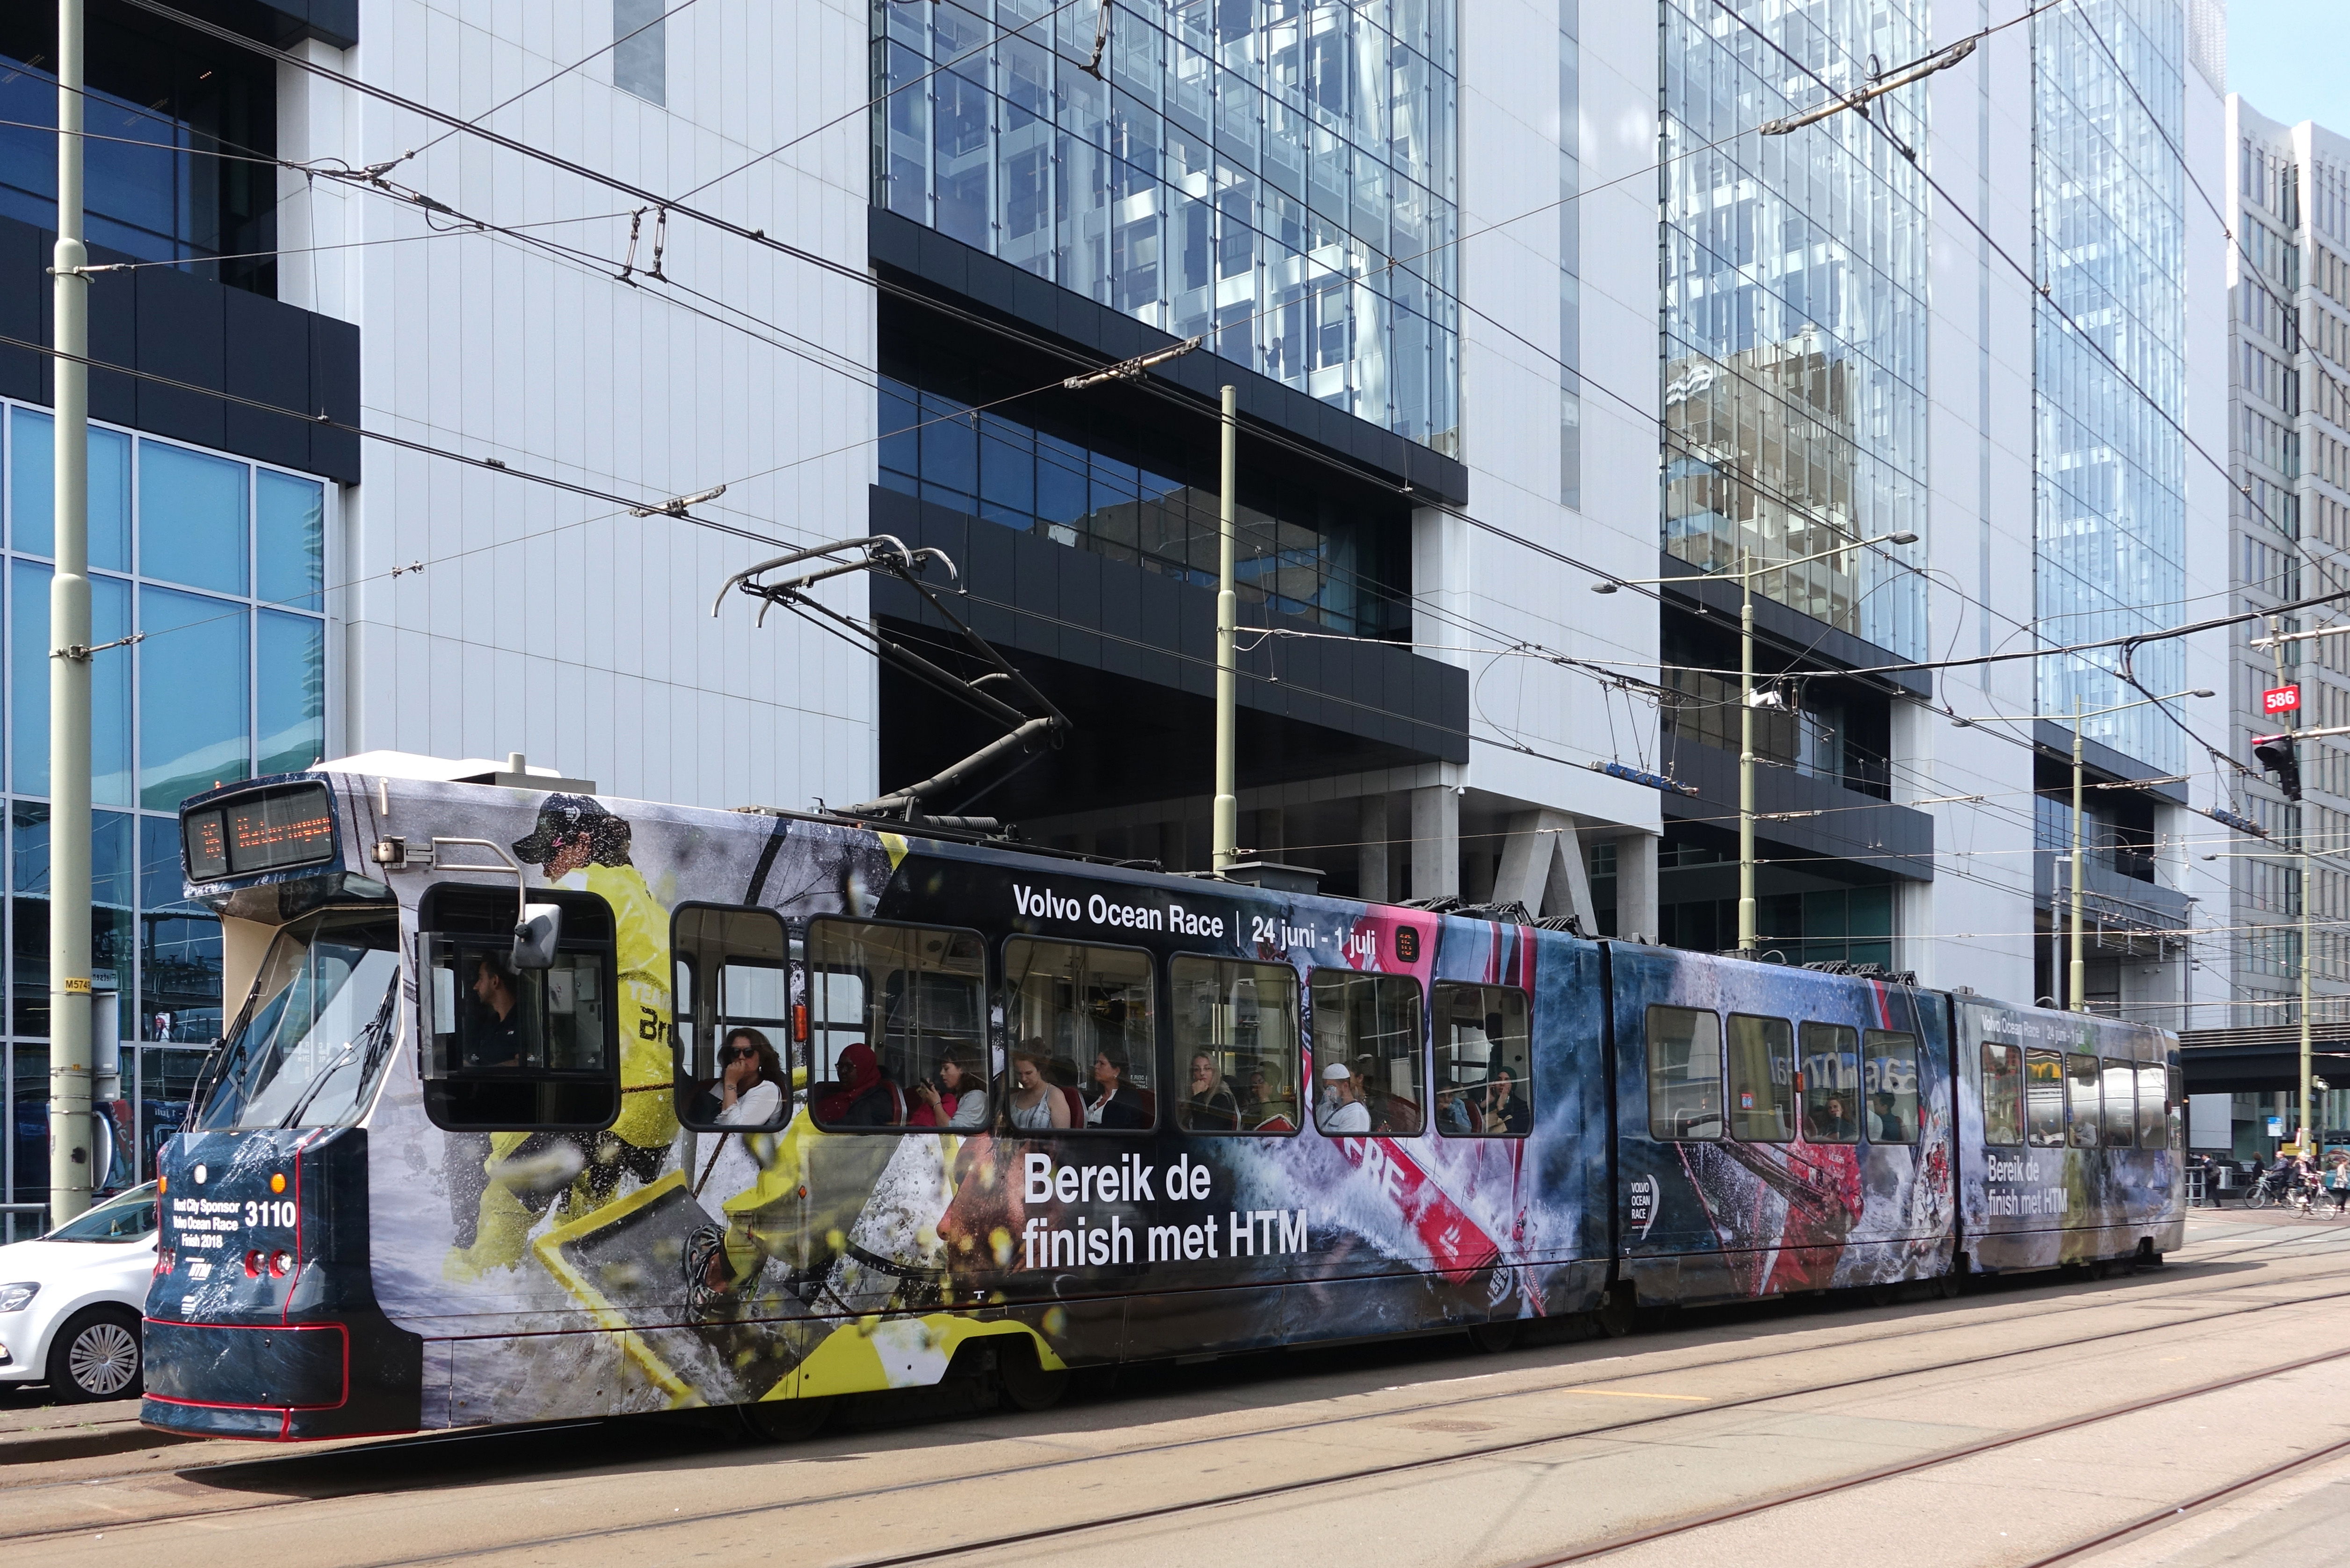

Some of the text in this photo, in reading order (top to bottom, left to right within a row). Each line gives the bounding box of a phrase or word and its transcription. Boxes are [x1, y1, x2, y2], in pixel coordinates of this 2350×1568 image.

[2267, 691, 2295, 708] 586
[1013, 884, 1080, 922] Volvo
[1088, 894, 1162, 931] Ocean
[1169, 904, 1224, 939] Race
[1252, 916, 1276, 942] 24
[1279, 918, 1315, 951] juni
[1334, 929, 1342, 951] 1
[1349, 928, 1376, 959] juli
[1981, 1014, 2000, 1032] Volvo
[2002, 1018, 2022, 1035] Ocean
[2024, 1021, 2040, 1038] Race
[2047, 1025, 2054, 1040] 24
[2055, 1026, 2066, 1044] juni
[2072, 1030, 2074, 1042] 1
[2075, 1030, 2084, 1047] juli
[1988, 1155, 2039, 1182] Bereik de
[1024, 1153, 1211, 1204] Bereik de
[1631, 1182, 1649, 1193] VOLVO
[174, 1199, 240, 1214] Host City Sponsor
[1632, 1195, 1650, 1206] OCEAN
[1987, 1188, 2067, 1216] finish met HTM
[245, 1201, 296, 1228] 3110
[1632, 1209, 1646, 1219] RACE
[173, 1215, 239, 1231] Volvo Ocean Race
[181, 1233, 223, 1248] Finish 2018
[1022, 1209, 1307, 1268] finish met HTM
[188, 1263, 212, 1278] HTM
